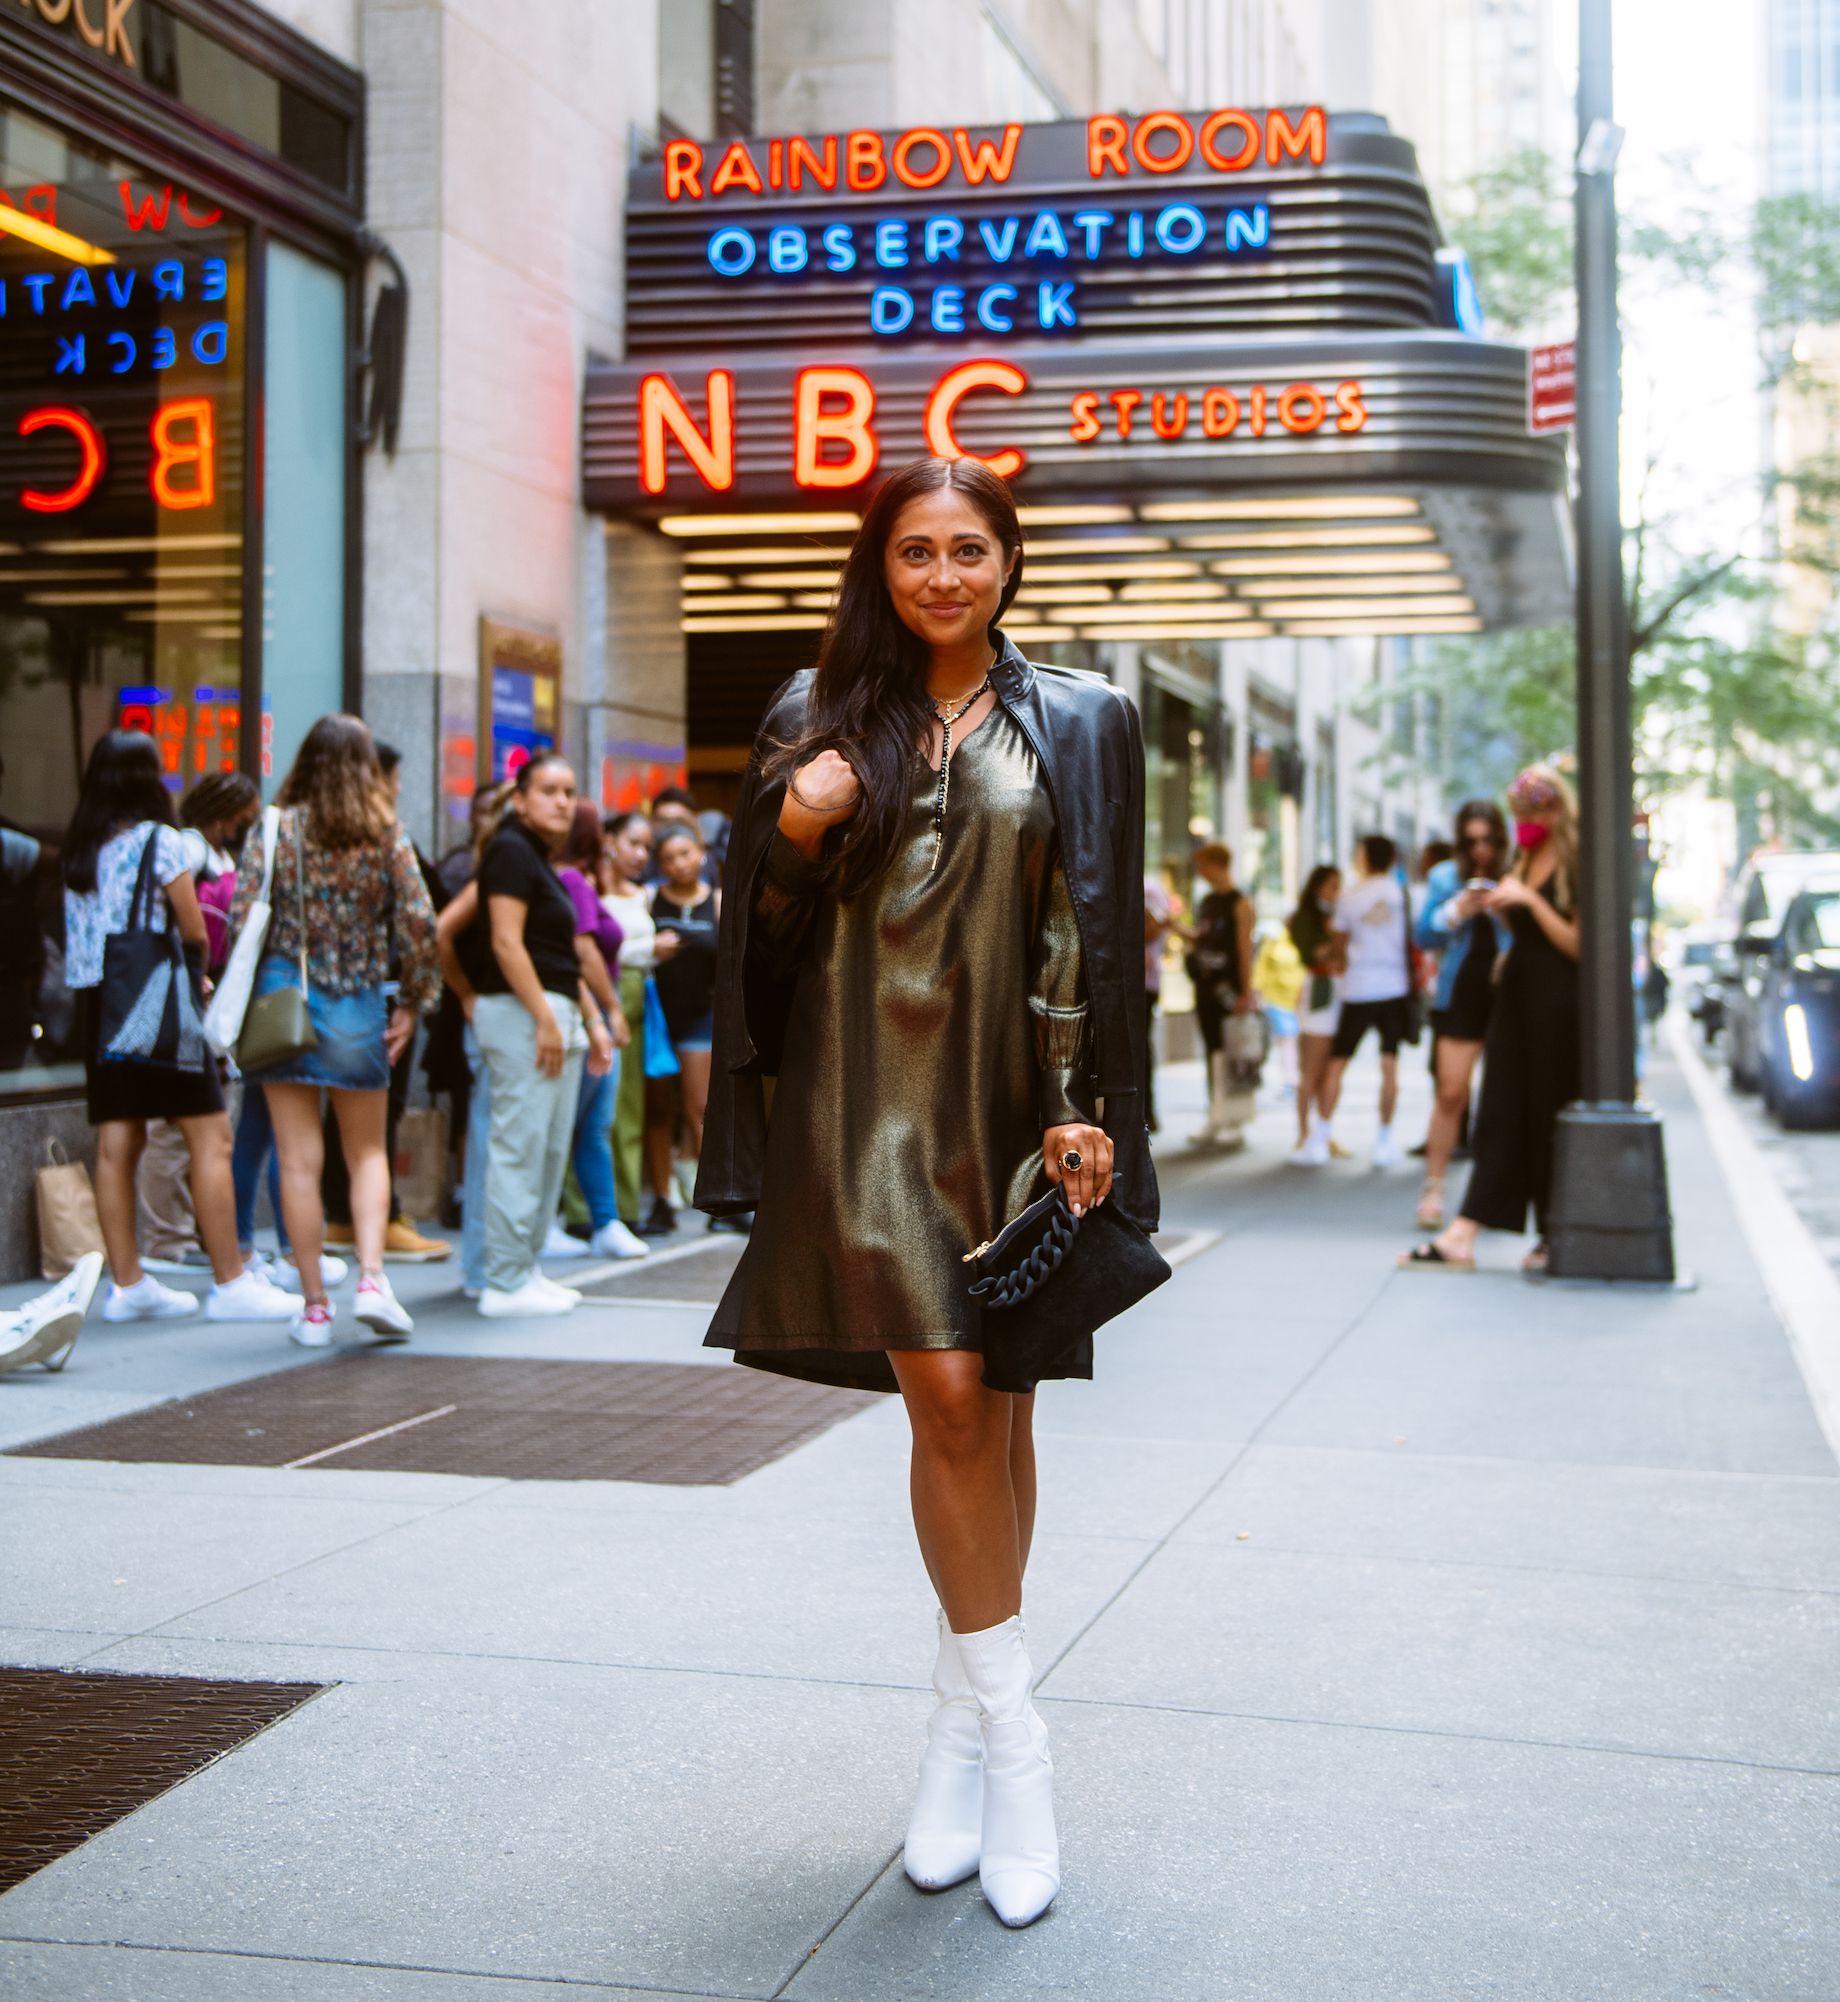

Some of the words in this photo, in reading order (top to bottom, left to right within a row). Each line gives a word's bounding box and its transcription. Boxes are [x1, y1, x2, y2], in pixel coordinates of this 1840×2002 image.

[663, 123, 1023, 200] RAINBOW
[1087, 105, 1327, 178] ROOM
[707, 202, 1270, 277] OBSERVATION
[870, 279, 1077, 335] DECK
[639, 358, 1027, 494] NBC
[1069, 380, 1367, 442] STUDIOS
